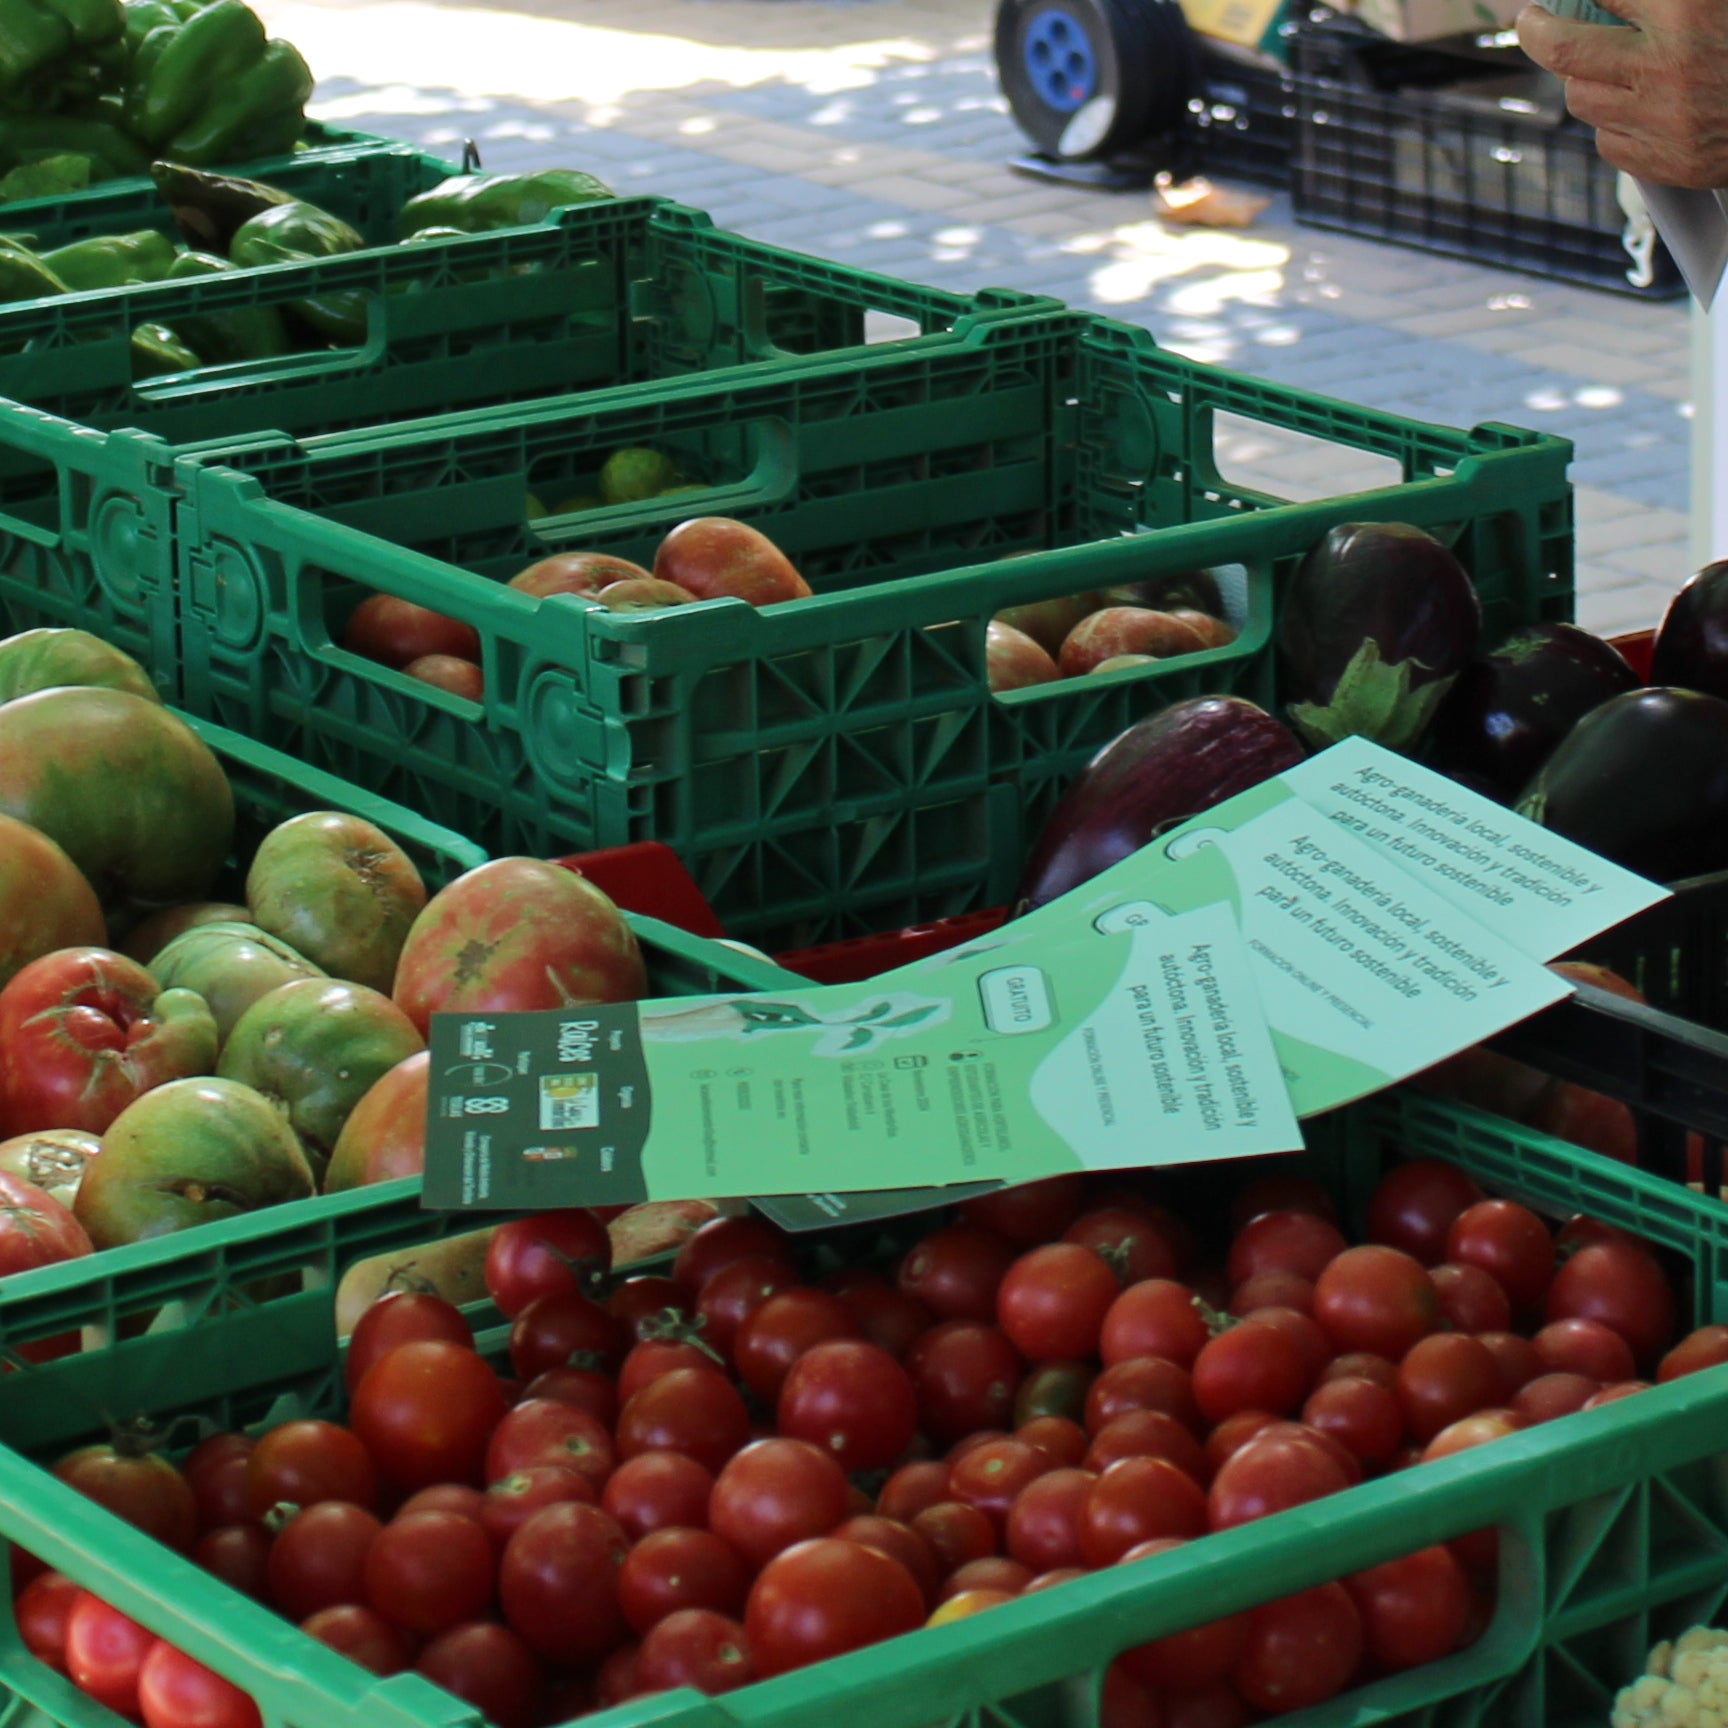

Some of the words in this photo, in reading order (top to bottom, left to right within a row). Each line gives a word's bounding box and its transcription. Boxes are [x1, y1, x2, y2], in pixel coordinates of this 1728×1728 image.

[1354, 766, 1471, 826] Agro-ganadería
[1465, 818, 1510, 849] local,
[1508, 841, 1591, 890] sostenible
[1580, 882, 1605, 896] y
[1329, 810, 1369, 834] para
[1366, 826, 1389, 844] un
[1386, 835, 1438, 869] futuro
[1432, 862, 1516, 909] sostenible
[1406, 818, 1490, 868] Innovación
[1482, 862, 1502, 873] y
[1500, 865, 1573, 909] tradición
[1288, 835, 1394, 909] Agro-ganadería
[1386, 901, 1431, 936] local,
[1424, 931, 1499, 980] sostenible
[1487, 976, 1511, 988] y
[1255, 885, 1294, 911] para
[1289, 906, 1312, 925] un
[1308, 918, 1355, 955] futuro
[1348, 949, 1422, 1000] sostenible
[1332, 897, 1408, 955] Innovación
[1396, 949, 1417, 961] y
[1414, 955, 1479, 1003] tradición
[1007, 977, 1033, 1022] GRATUITO
[1129, 984, 1152, 1010] para
[1159, 955, 1190, 1014] autóctona.
[1188, 944, 1233, 1031] Agro-ganadería
[1140, 1011, 1156, 1026] un
[1143, 1026, 1168, 1060] futuro
[1175, 1016, 1208, 1074] Innovación
[1217, 1032, 1243, 1062] local,
[1151, 1062, 1183, 1114] sostenible
[1186, 1075, 1207, 1083] y
[1224, 1065, 1259, 1119] sostenible
[1194, 1083, 1224, 1132] tradición
[1236, 1120, 1259, 1128] y
